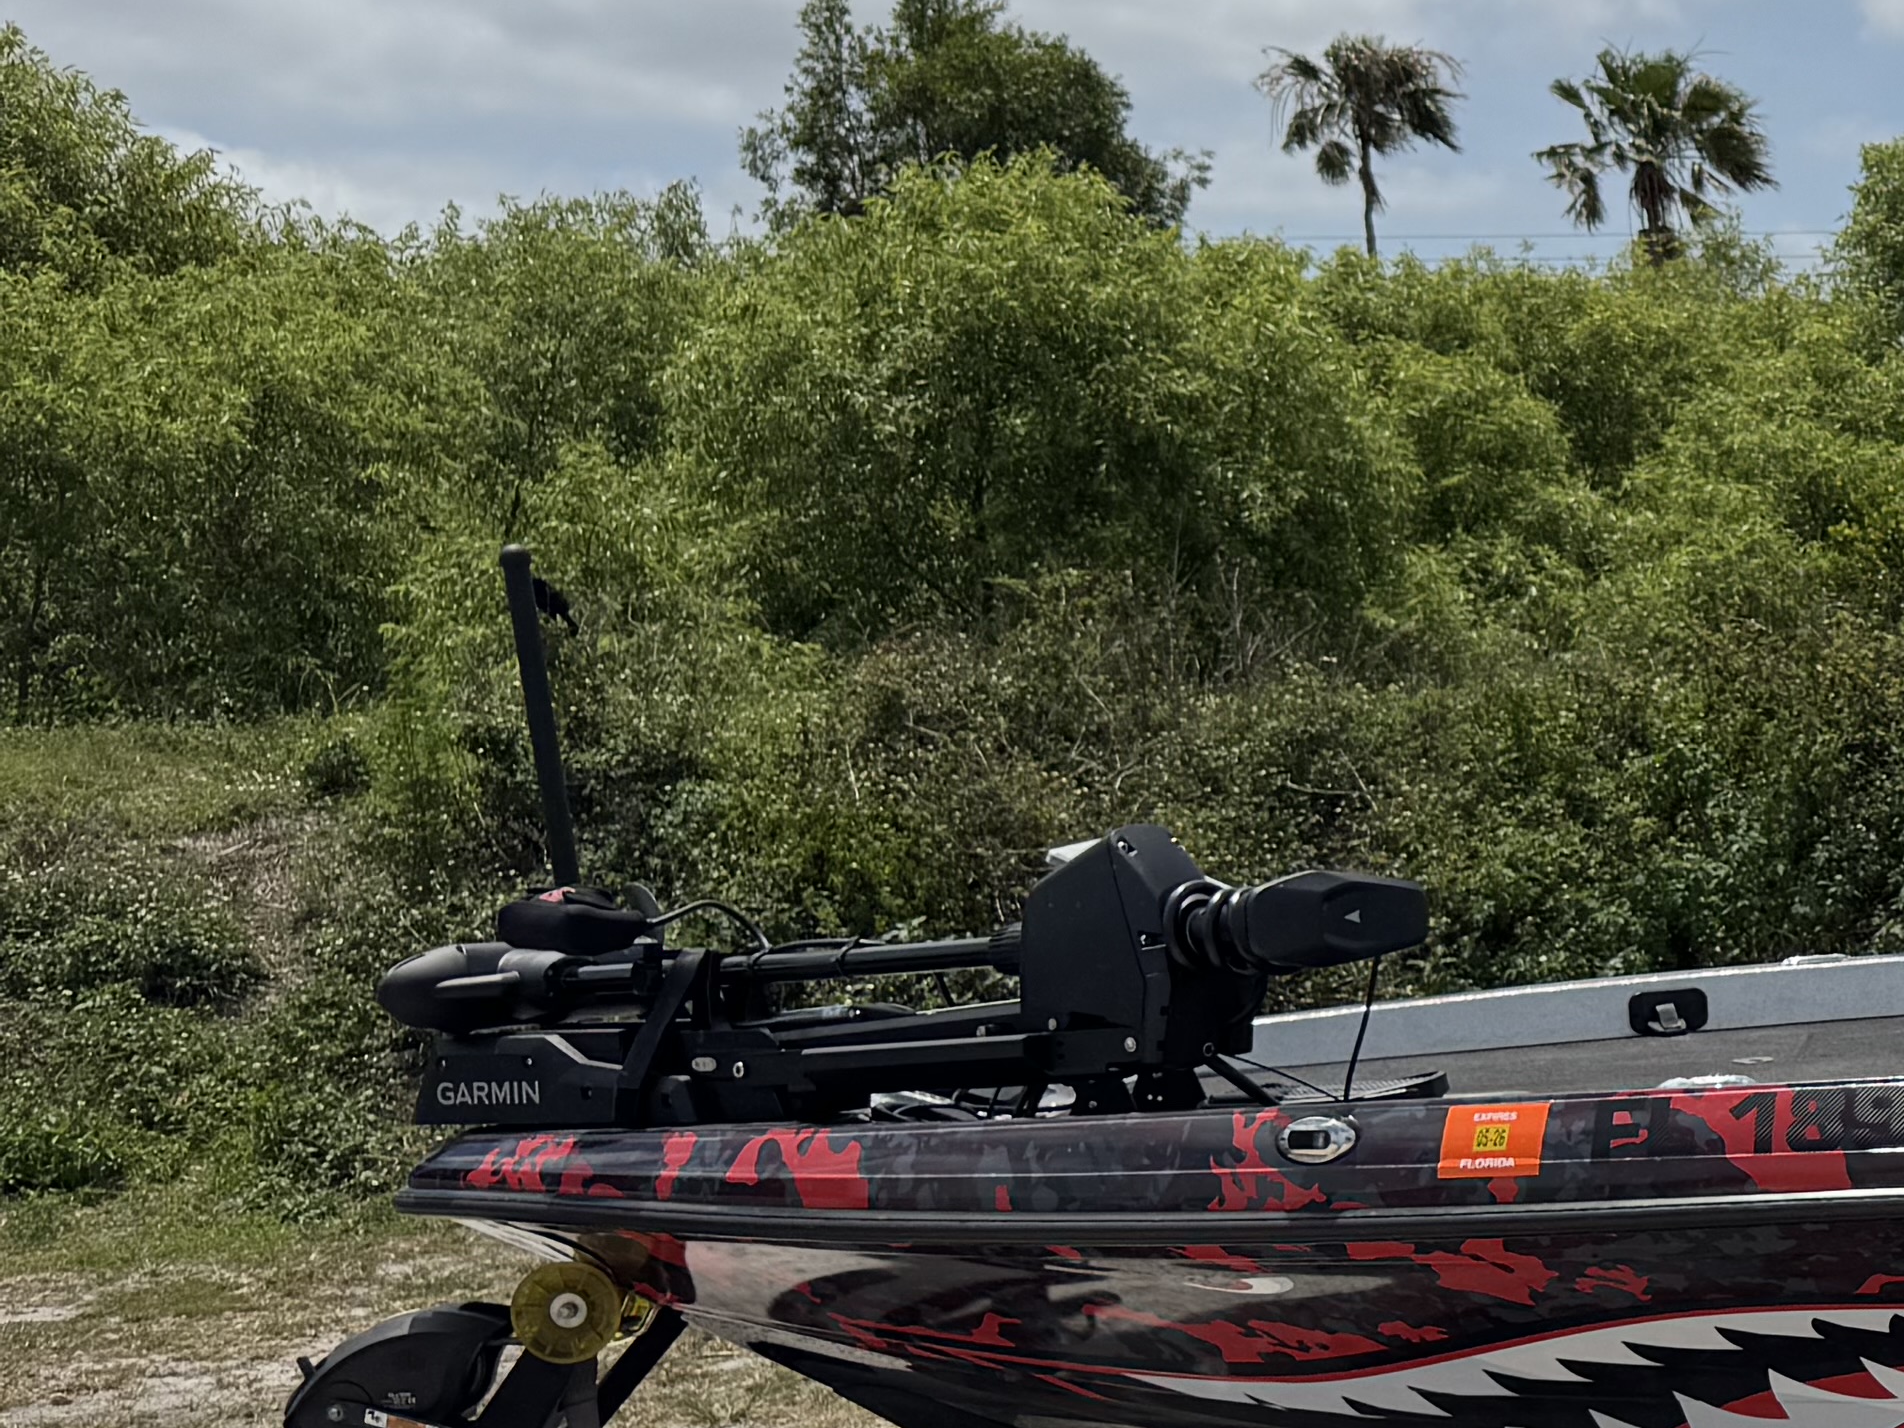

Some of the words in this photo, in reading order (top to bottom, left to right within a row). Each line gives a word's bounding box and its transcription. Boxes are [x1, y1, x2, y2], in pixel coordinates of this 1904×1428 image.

[436, 1080, 540, 1106] GARMIN
[1473, 1111, 1518, 1122] EXPIRES
[1476, 1127, 1507, 1148] 05-26
[1460, 1157, 1516, 1170] FLORIDA
